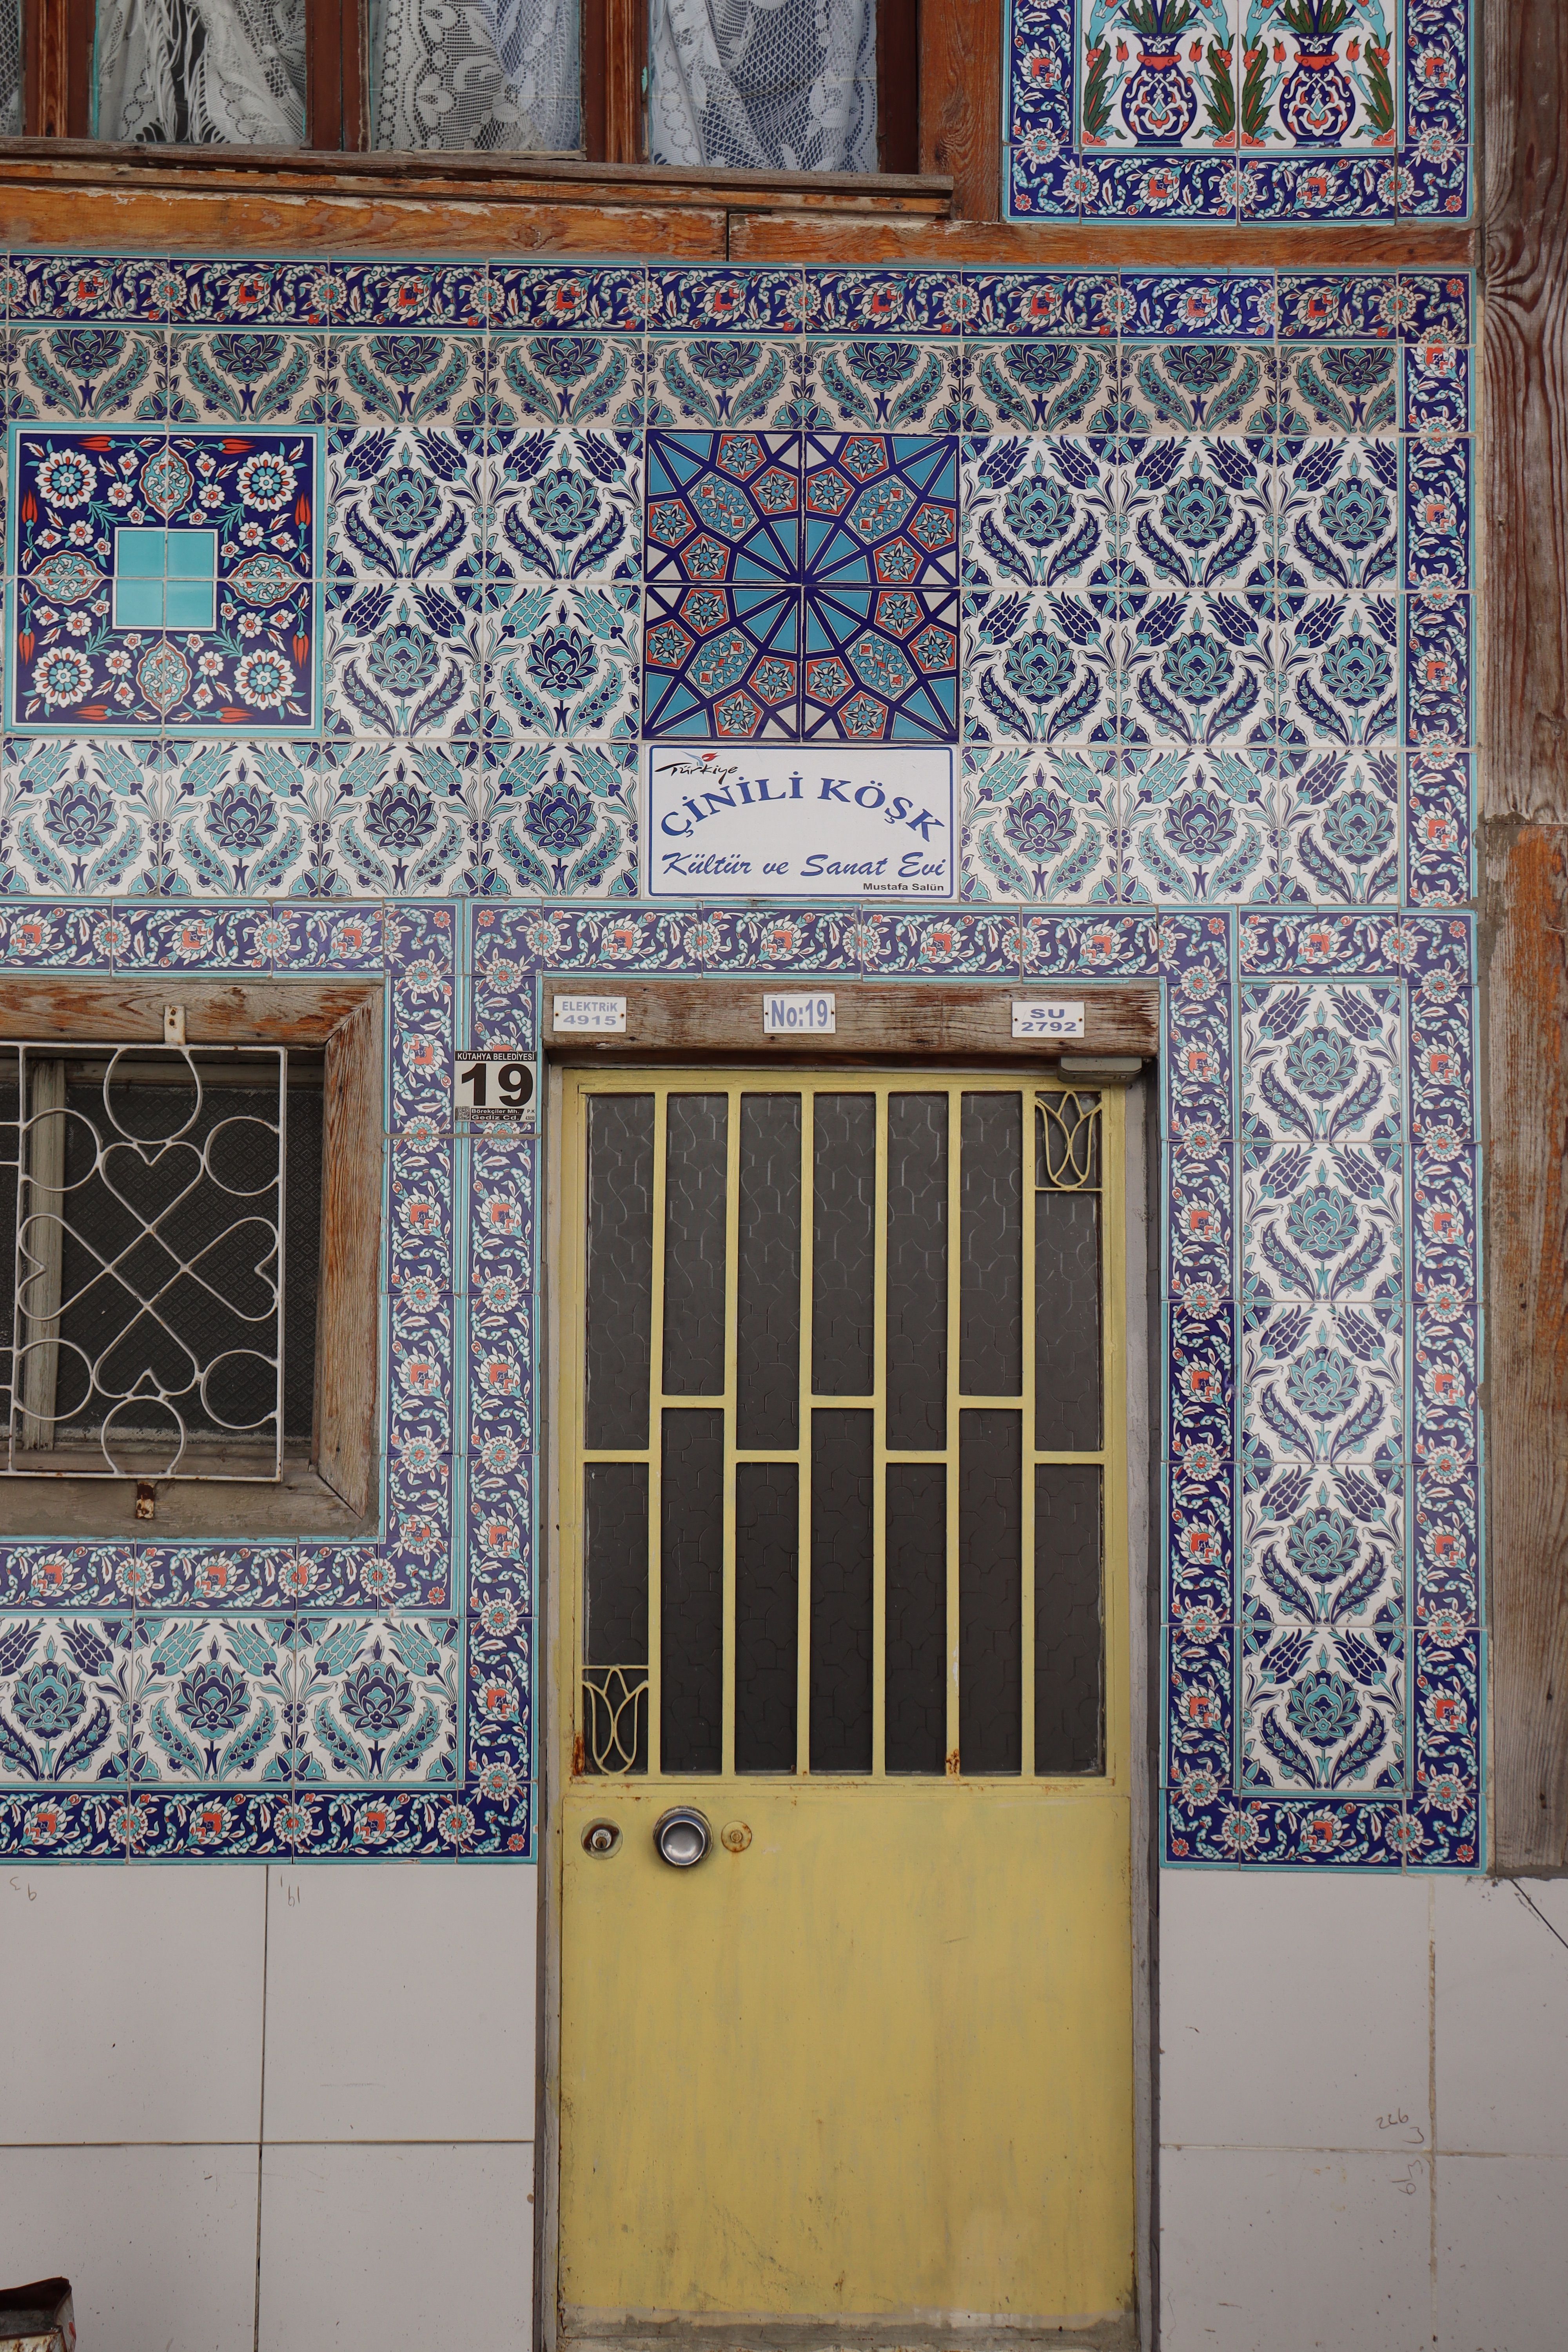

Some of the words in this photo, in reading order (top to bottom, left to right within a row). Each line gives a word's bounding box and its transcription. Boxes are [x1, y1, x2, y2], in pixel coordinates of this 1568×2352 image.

[654, 762, 739, 785] Türkiye
[661, 771, 804, 838] ÇİNİLİ
[817, 777, 945, 842] KÖŞK
[662, 852, 752, 876] Kültür
[763, 862, 789, 876] ve
[800, 854, 888, 877] Sanat
[898, 852, 946, 878] Evi
[863, 883, 908, 891] Mustafa
[911, 883, 944, 891] Salün
[563, 1014, 617, 1025] 4915
[771, 999, 828, 1027] No:19
[1030, 1008, 1065, 1019] SU
[1021, 1022, 1077, 1032] 2792
[457, 1051, 492, 1061] KÜTAHYA
[493, 1051, 535, 1061] BELEDİYESİ
[461, 1063, 533, 1107] 19
